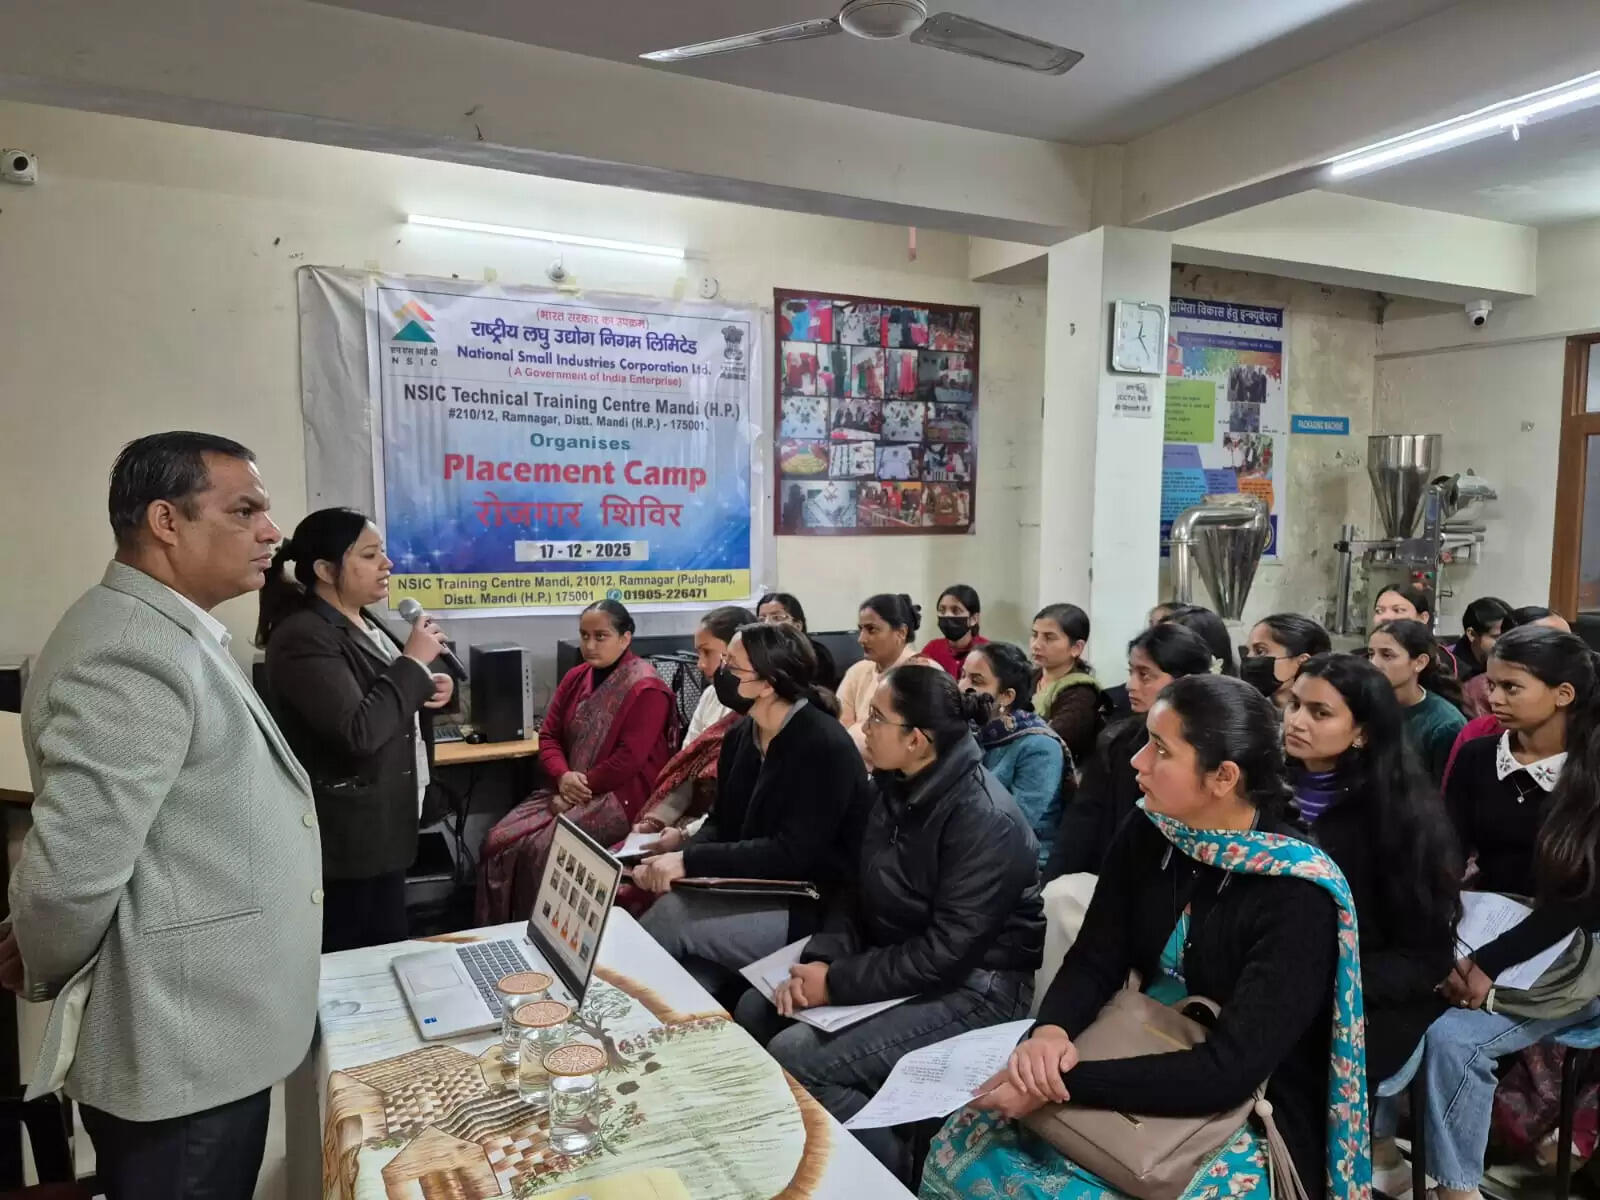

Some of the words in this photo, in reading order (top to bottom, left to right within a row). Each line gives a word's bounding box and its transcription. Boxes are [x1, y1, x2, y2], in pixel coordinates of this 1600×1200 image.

[536, 308, 564, 321] (भारत
[568, 312, 599, 326] सरकार
[1170, 299, 1196, 315] द्यमिता
[1198, 301, 1225, 317] विकास
[470, 317, 519, 344] राष्ट्रीय
[523, 325, 551, 350] लघु
[554, 325, 595, 347] उद्योग
[599, 327, 642, 350] निगम
[646, 331, 698, 355] लिमिटेड
[457, 344, 514, 362] National
[518, 350, 553, 365] Small
[556, 353, 616, 369] Industries
[619, 358, 689, 374] Corporation
[692, 361, 711, 376] Ltd.
[525, 367, 588, 381] Government
[590, 371, 600, 381] of
[602, 373, 627, 384] India
[630, 375, 682, 388] Enterprise)
[404, 383, 447, 402] NSIC
[451, 386, 529, 407] Technical
[533, 391, 597, 415] Training
[602, 396, 651, 413] Centre
[655, 398, 700, 416] Mandi
[704, 401, 740, 422] (H.P.)
[448, 407, 498, 423] #210/12,
[502, 410, 561, 426] Ramnagar,
[564, 414, 593, 427] Distt.
[596, 416, 628, 429] Mandi
[631, 418, 661, 431] (H.P.)
[530, 432, 632, 451] Organises
[443, 453, 616, 485] Placement
[623, 460, 707, 493] Camp
[472, 490, 583, 528] रोजगार
[600, 494, 684, 528] शिविर
[397, 577, 432, 590] NSIC
[436, 577, 488, 591] Training
[491, 576, 532, 589] Centre
[534, 575, 573, 588] Mandi,
[619, 575, 674, 587] Ramnagar
[444, 593, 477, 605] Distt.
[480, 592, 517, 604] Mandi
[520, 591, 552, 605] (H.P.)
[555, 591, 594, 602] 175001
[623, 588, 708, 601] 01905-226471
